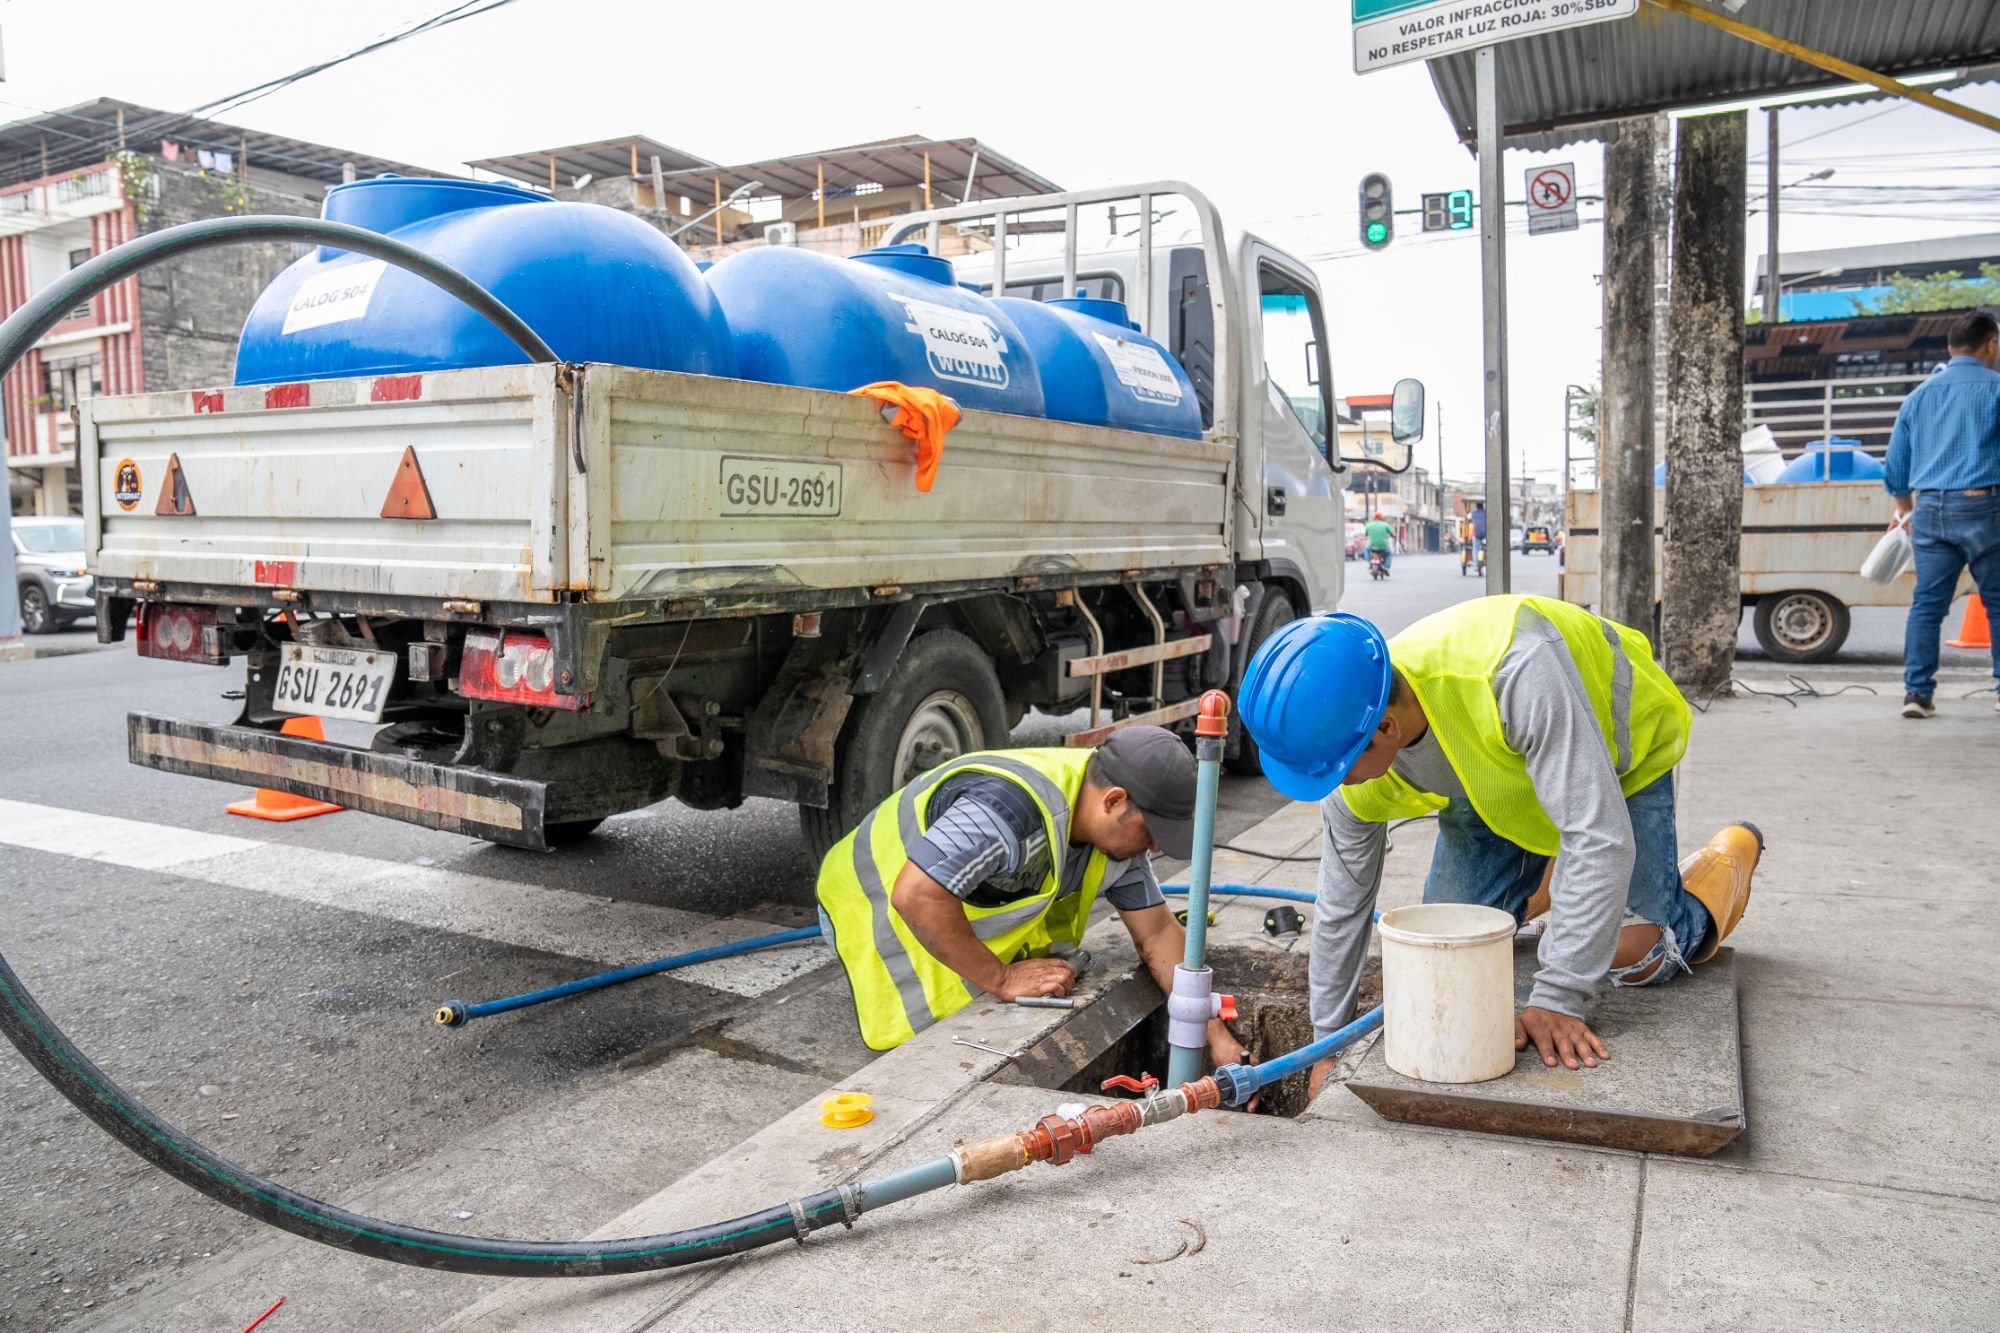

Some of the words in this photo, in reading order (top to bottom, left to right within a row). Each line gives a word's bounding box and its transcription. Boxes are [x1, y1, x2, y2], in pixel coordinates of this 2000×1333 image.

[1368, 47, 1388, 61] NO
[1392, 28, 1463, 54] RESPETAR
[1468, 19, 1496, 37] LUZ
[1501, 11, 1547, 29] ROJA:
[1399, 14, 1445, 36] VALOR
[1449, 0, 1541, 24] INFRACCIO
[293, 289, 341, 312] CALOG
[929, 327, 968, 345] CALOG
[968, 336, 989, 349] 504
[726, 472, 835, 508] GSU-2691
[313, 649, 357, 666] ECUADOR
[278, 665, 319, 704] GSU
[325, 671, 384, 713] 2691
